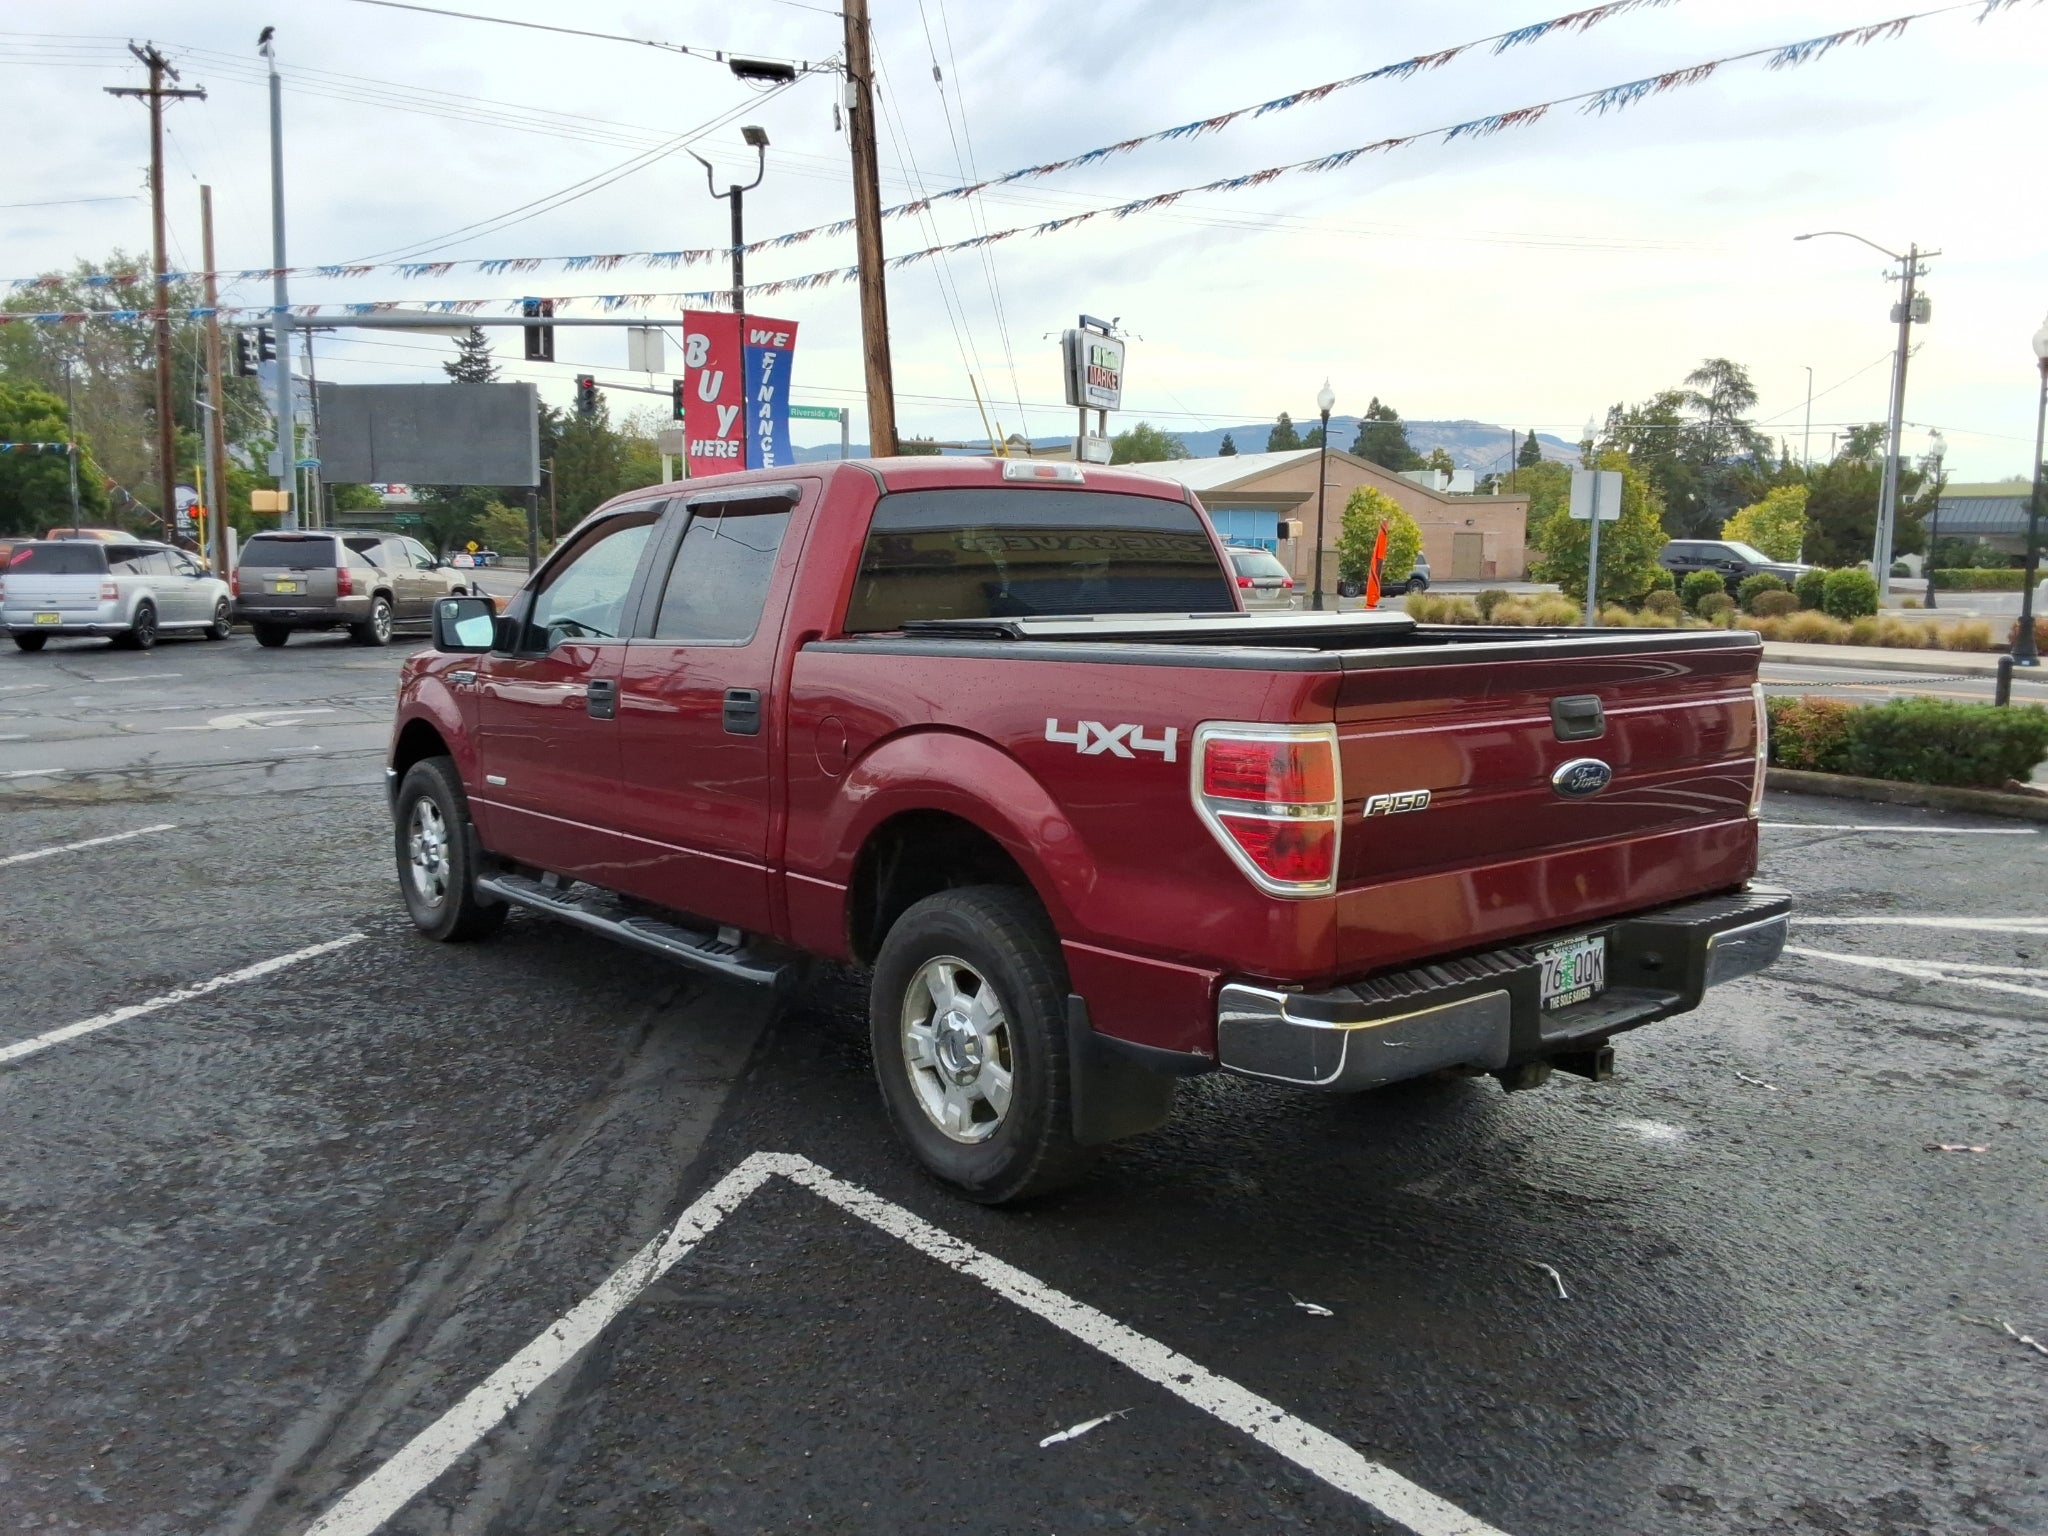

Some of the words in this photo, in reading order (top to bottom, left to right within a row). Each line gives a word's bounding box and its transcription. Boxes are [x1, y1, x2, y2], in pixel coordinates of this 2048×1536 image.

[750, 328, 790, 347] WE
[685, 333, 740, 438] BUY
[757, 351, 777, 469] FINANCE
[790, 408, 826, 418] Riverside
[690, 439, 740, 459] HERE
[374, 483, 408, 495] edEx
[1571, 766, 1606, 790] Ford
[1544, 957, 1563, 993] 76
[1550, 997, 1560, 1010] THE
[1572, 986, 1591, 1004] SAVERS
